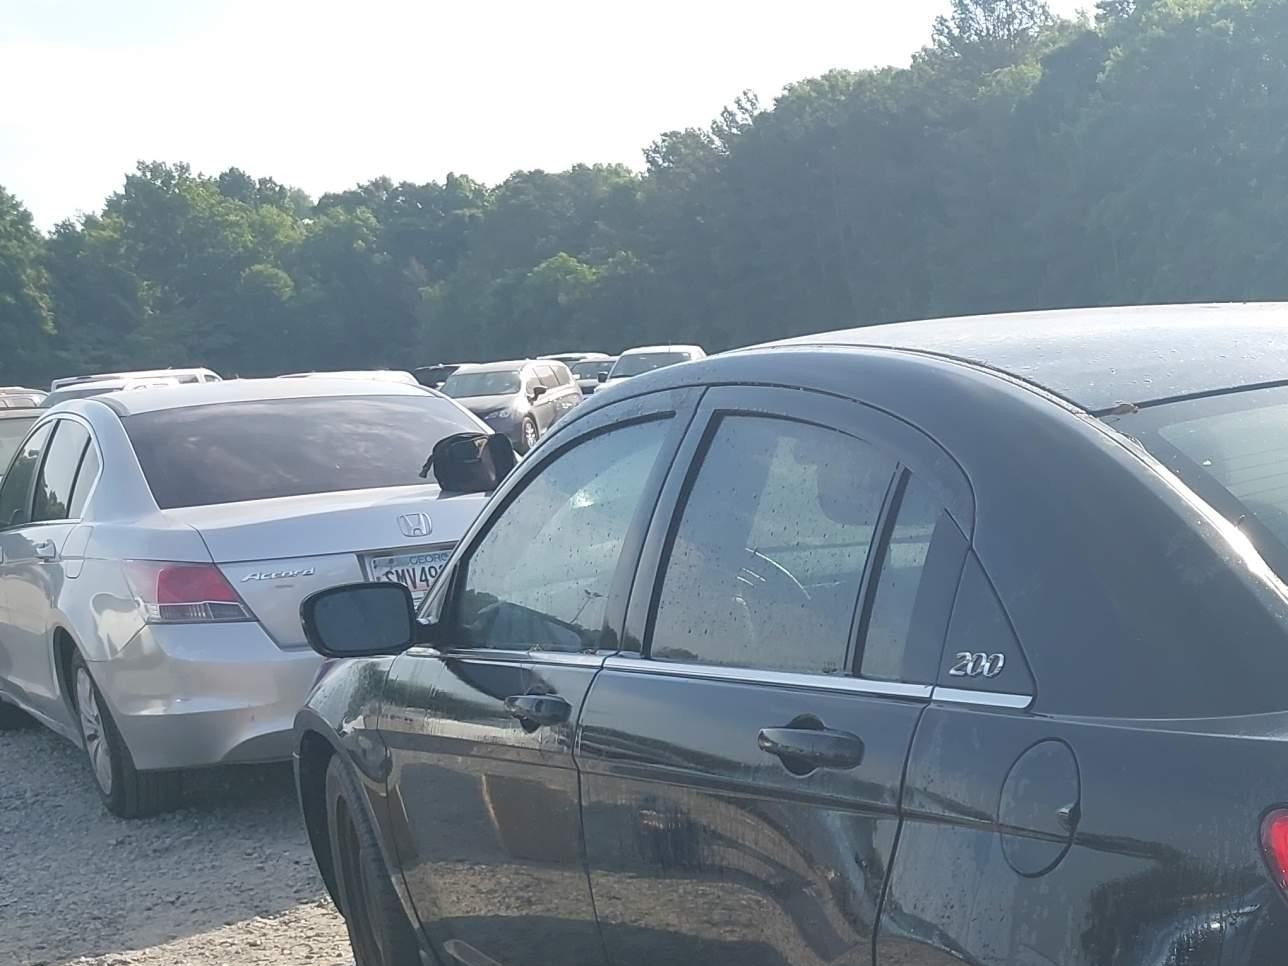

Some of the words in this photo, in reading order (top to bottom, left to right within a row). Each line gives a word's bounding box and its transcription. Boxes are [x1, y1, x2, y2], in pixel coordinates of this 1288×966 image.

[409, 552, 452, 565] GEORG
[240, 567, 316, 584] Accord
[382, 564, 444, 589] SMV49
[948, 651, 1005, 677] 200
